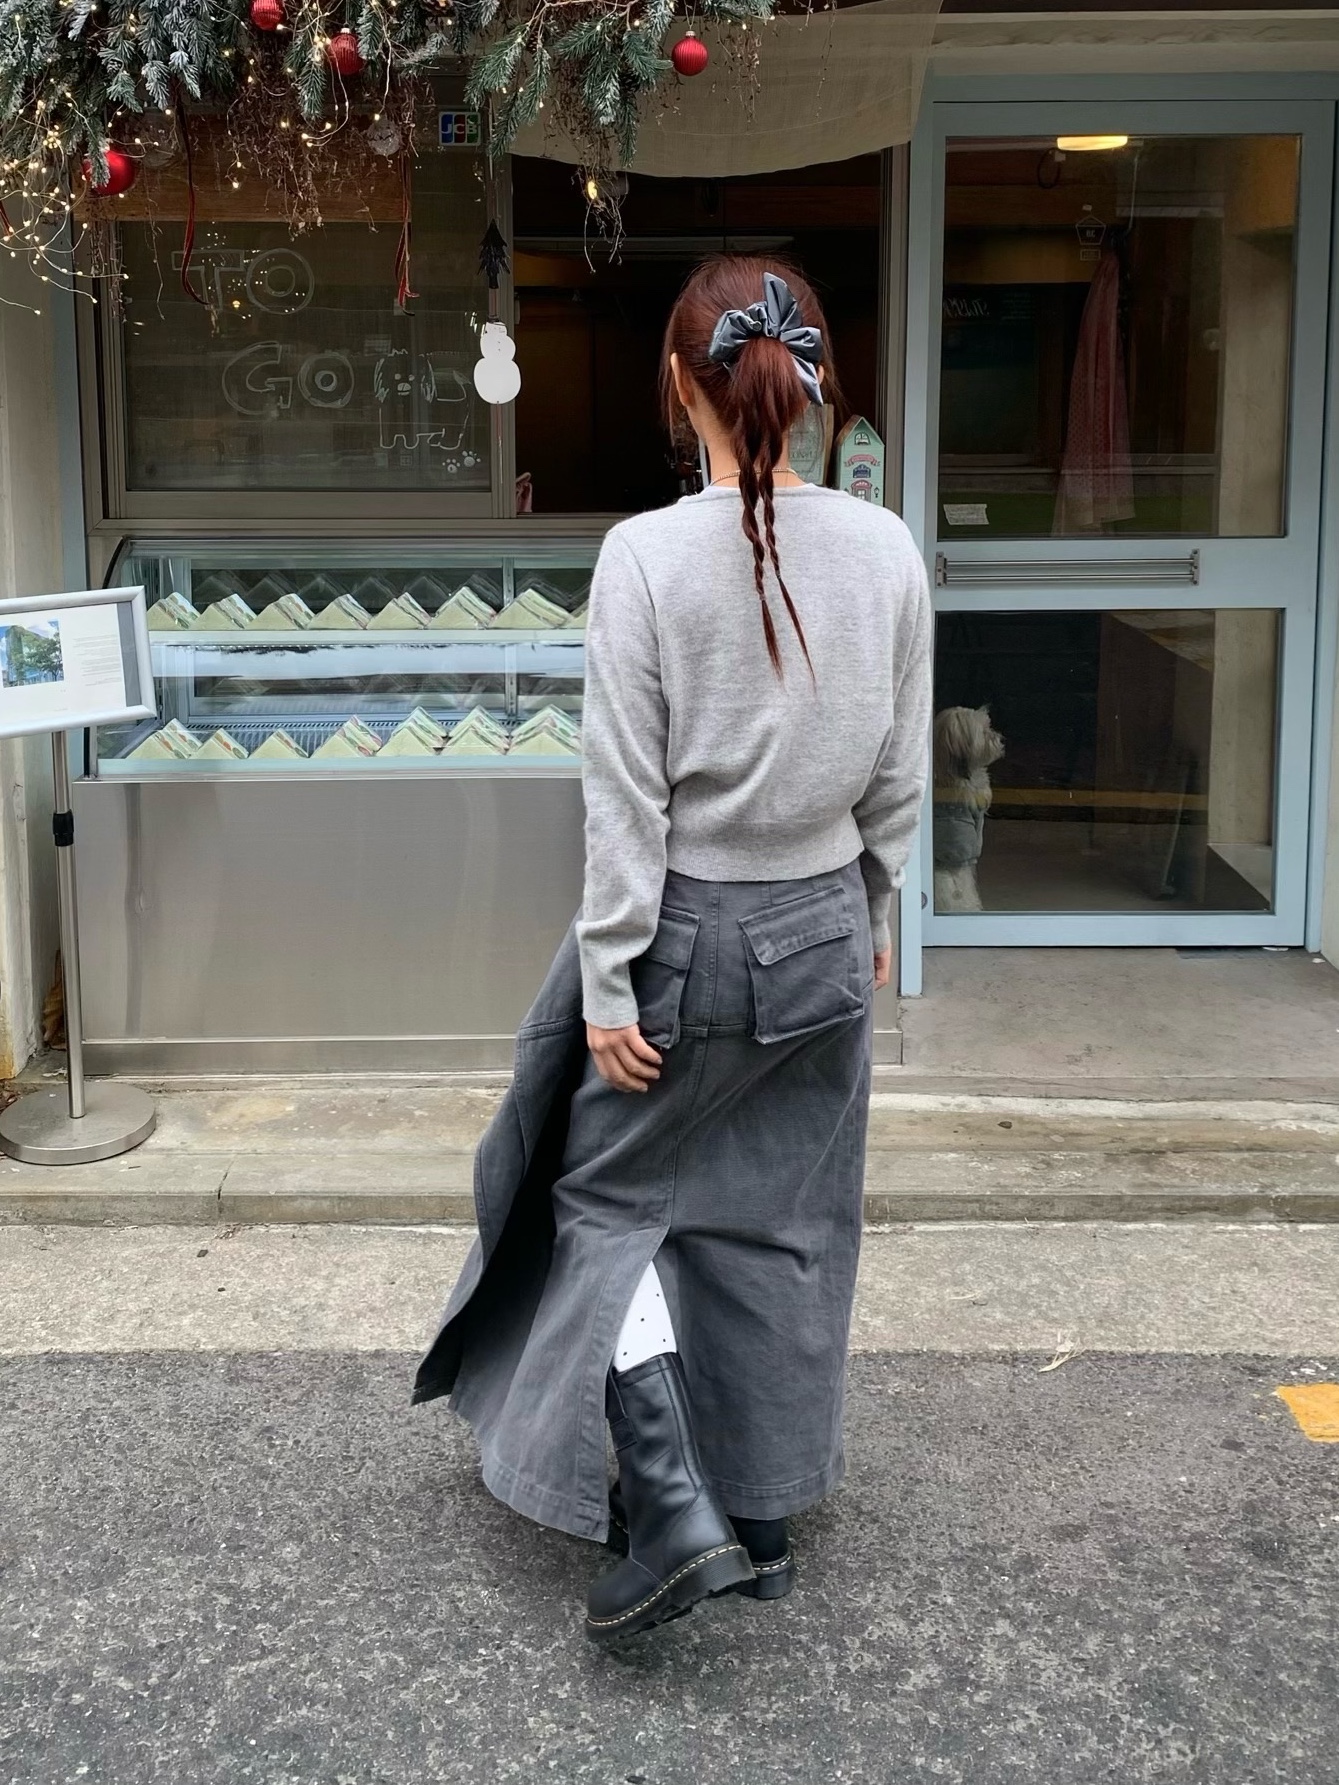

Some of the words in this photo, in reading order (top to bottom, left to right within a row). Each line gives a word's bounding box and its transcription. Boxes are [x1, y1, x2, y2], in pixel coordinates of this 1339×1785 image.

[441, 123, 477, 134] JCB
[171, 248, 315, 315] TO
[222, 341, 355, 416] GO
